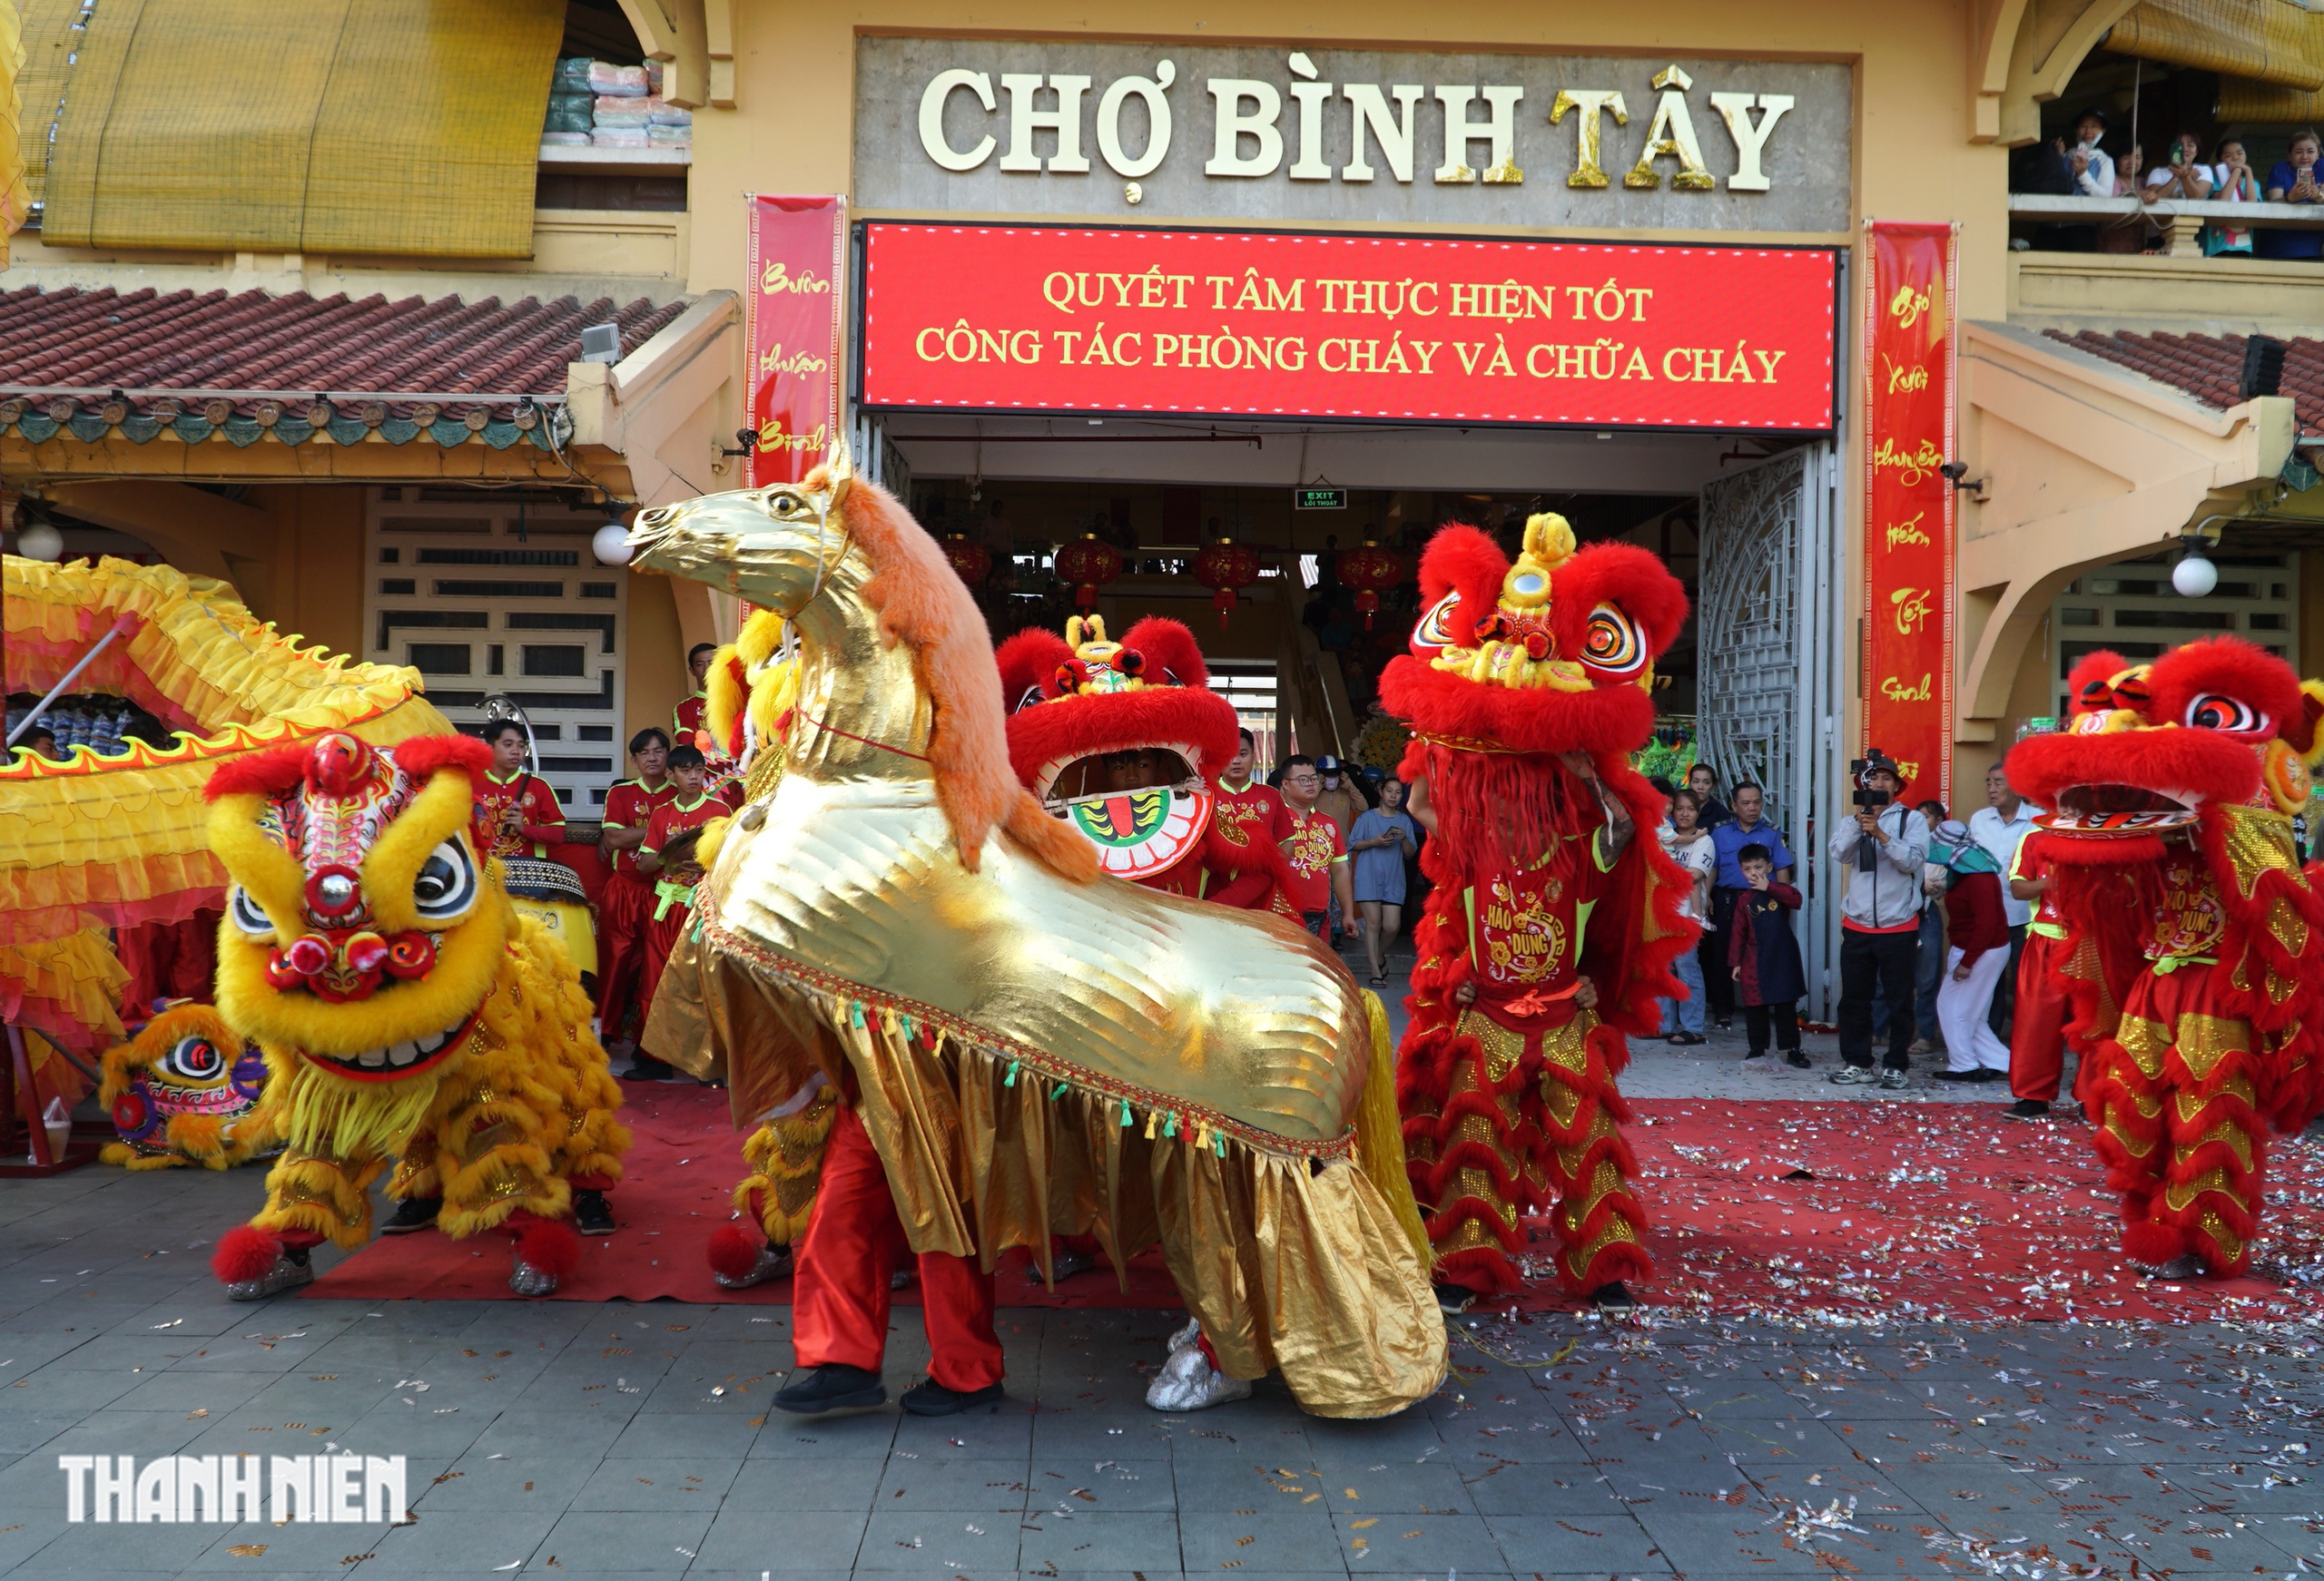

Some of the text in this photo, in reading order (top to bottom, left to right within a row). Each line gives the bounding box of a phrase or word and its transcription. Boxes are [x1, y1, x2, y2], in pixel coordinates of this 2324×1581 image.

[918, 52, 1796, 204] CHỢ BÌNH TÂY
[1043, 265, 1653, 324] QUYẾT TÂM THỰC HIỆN TỐT
[916, 319, 1787, 383] CÔNG TÁC PHÒNG CHÁY VÀ CHỮA CHÁY
[1488, 900, 1512, 931] HÀO
[1512, 928, 1549, 956] DŨNG
